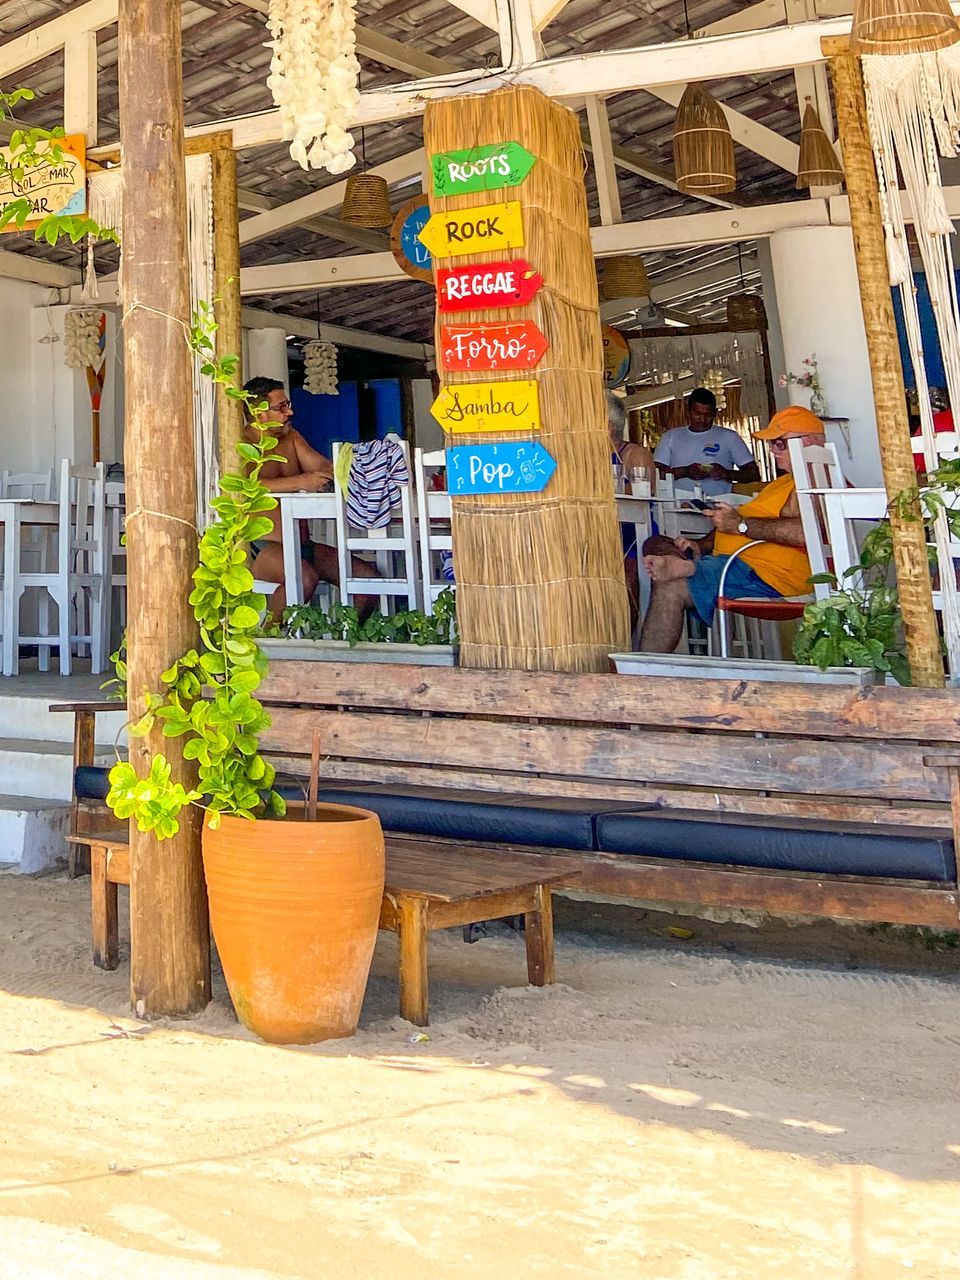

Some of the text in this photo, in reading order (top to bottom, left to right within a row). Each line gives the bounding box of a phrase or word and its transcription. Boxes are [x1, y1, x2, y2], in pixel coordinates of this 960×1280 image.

[49, 167, 69, 180] MAR
[448, 152, 511, 183] ROOTS
[445, 216, 504, 243] ROCK
[445, 271, 517, 300] REGGAE
[451, 333, 526, 362] Forró
[441, 389, 528, 420] Samba
[469, 456, 514, 488] Pop
